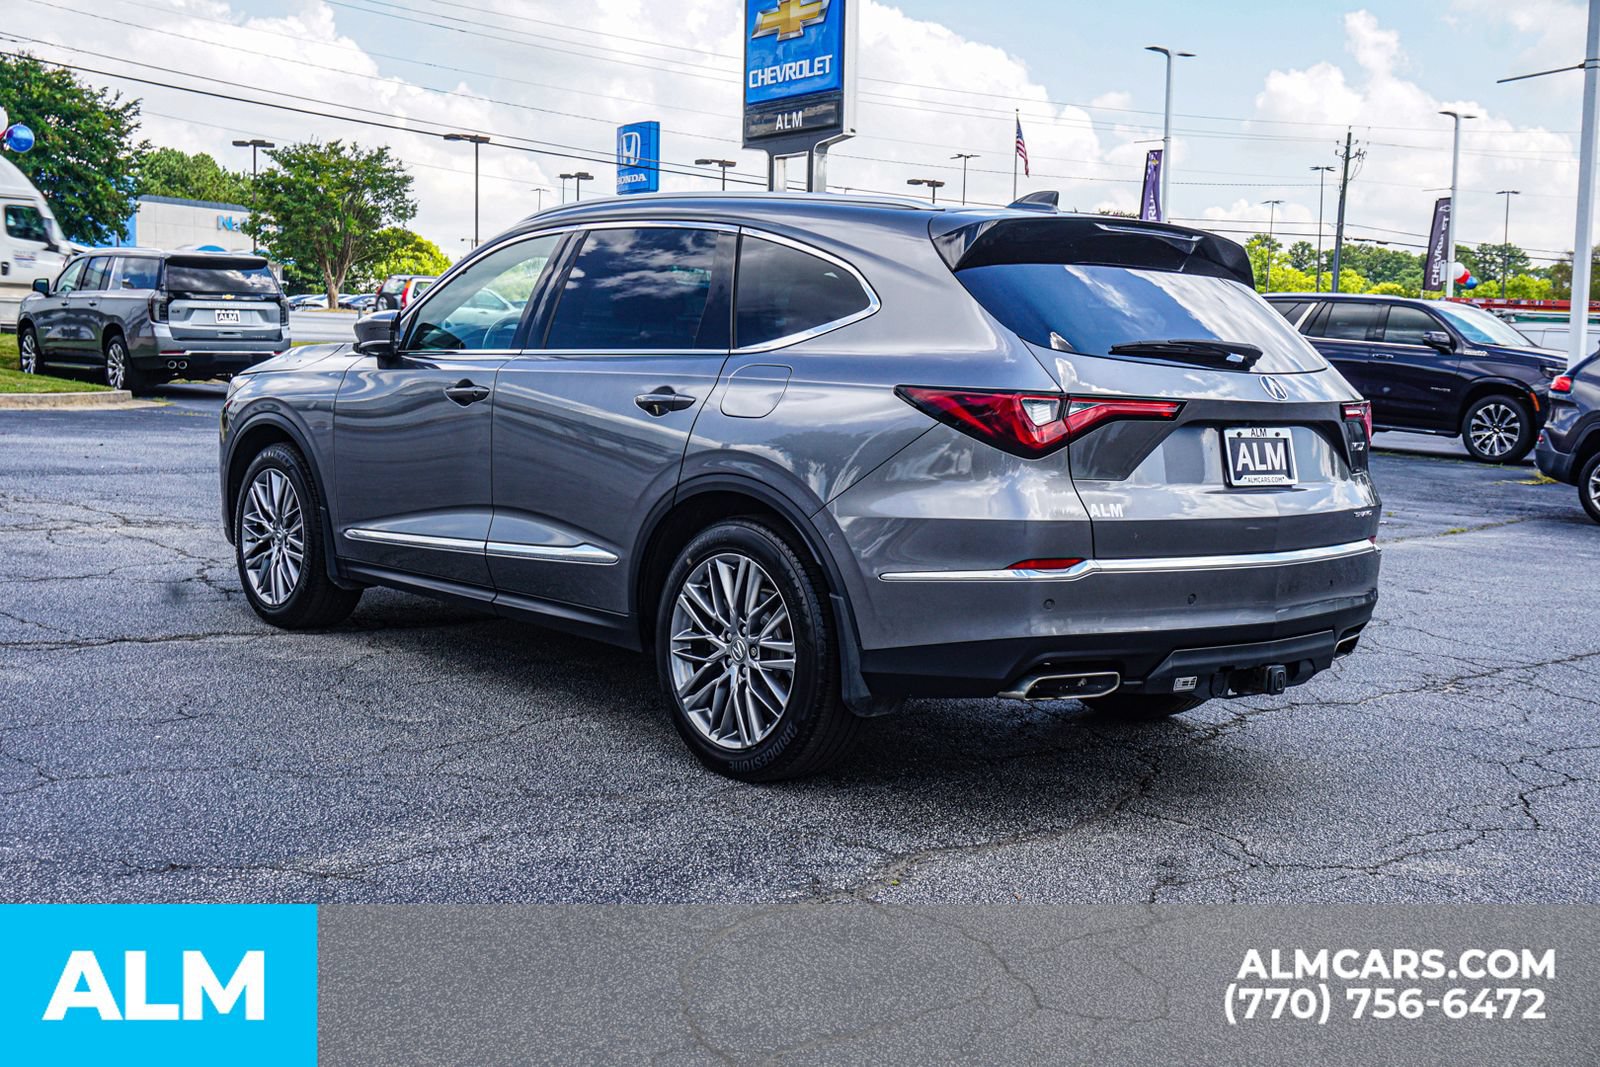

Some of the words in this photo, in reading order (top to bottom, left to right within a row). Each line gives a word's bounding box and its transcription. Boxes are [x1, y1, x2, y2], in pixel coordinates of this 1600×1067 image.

[749, 54, 833, 89] CHEVROLET
[775, 110, 803, 131] ALM
[218, 313, 237, 321] ALM
[1250, 428, 1268, 438] ALM
[1236, 442, 1287, 472] ALM
[1090, 503, 1124, 518] ALM
